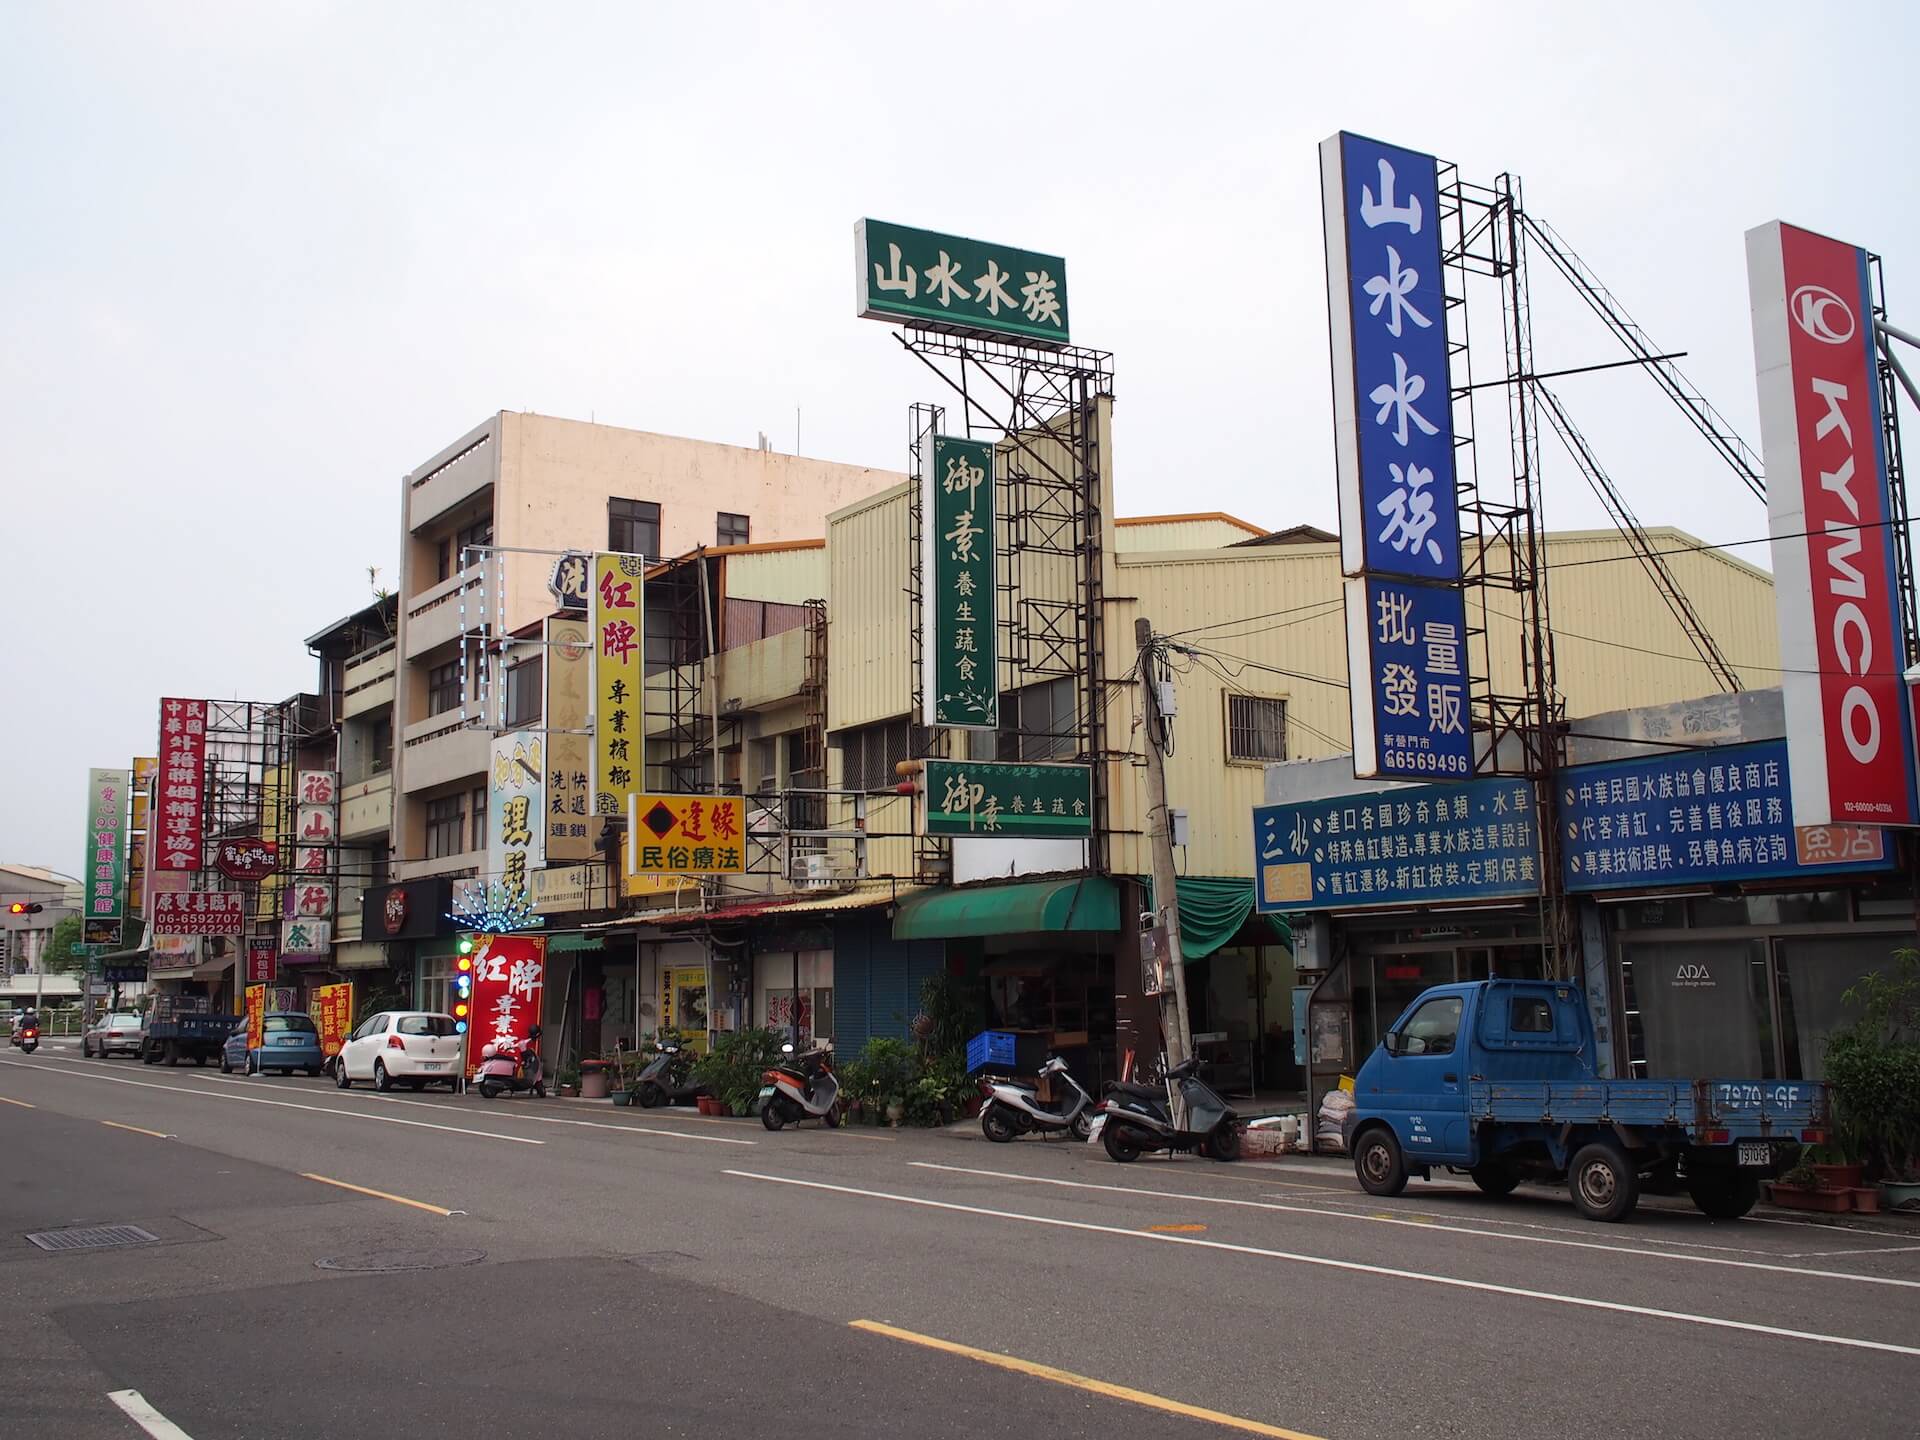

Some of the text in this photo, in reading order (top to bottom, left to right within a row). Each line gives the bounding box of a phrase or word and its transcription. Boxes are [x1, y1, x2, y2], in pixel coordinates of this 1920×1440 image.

[875, 243, 1061, 327] 山水水族
[1360, 158, 1442, 565] 山水水族
[943, 455, 984, 563] 御素
[1812, 377, 1880, 764] KYMCO
[600, 569, 638, 665] 紅牌
[954, 571, 977, 681] 養生蔬食
[1377, 591, 1421, 717] 批發
[1423, 621, 1465, 735] 量販
[608, 679, 631, 789] 專業檳榔
[1383, 733, 1430, 749] 新營門市
[1396, 751, 1467, 772] 6569496
[1011, 796, 1085, 816] 養生蔬食
[1580, 760, 1779, 808] 中華民國水族協會優良商店
[681, 800, 739, 841] 逢緣
[641, 846, 739, 869] 民俗療法
[156, 924, 241, 935] 0921242249
[158, 913, 240, 924] 06-6592707
[473, 944, 543, 1002] 紅牌
[1676, 964, 1710, 979] ADA
